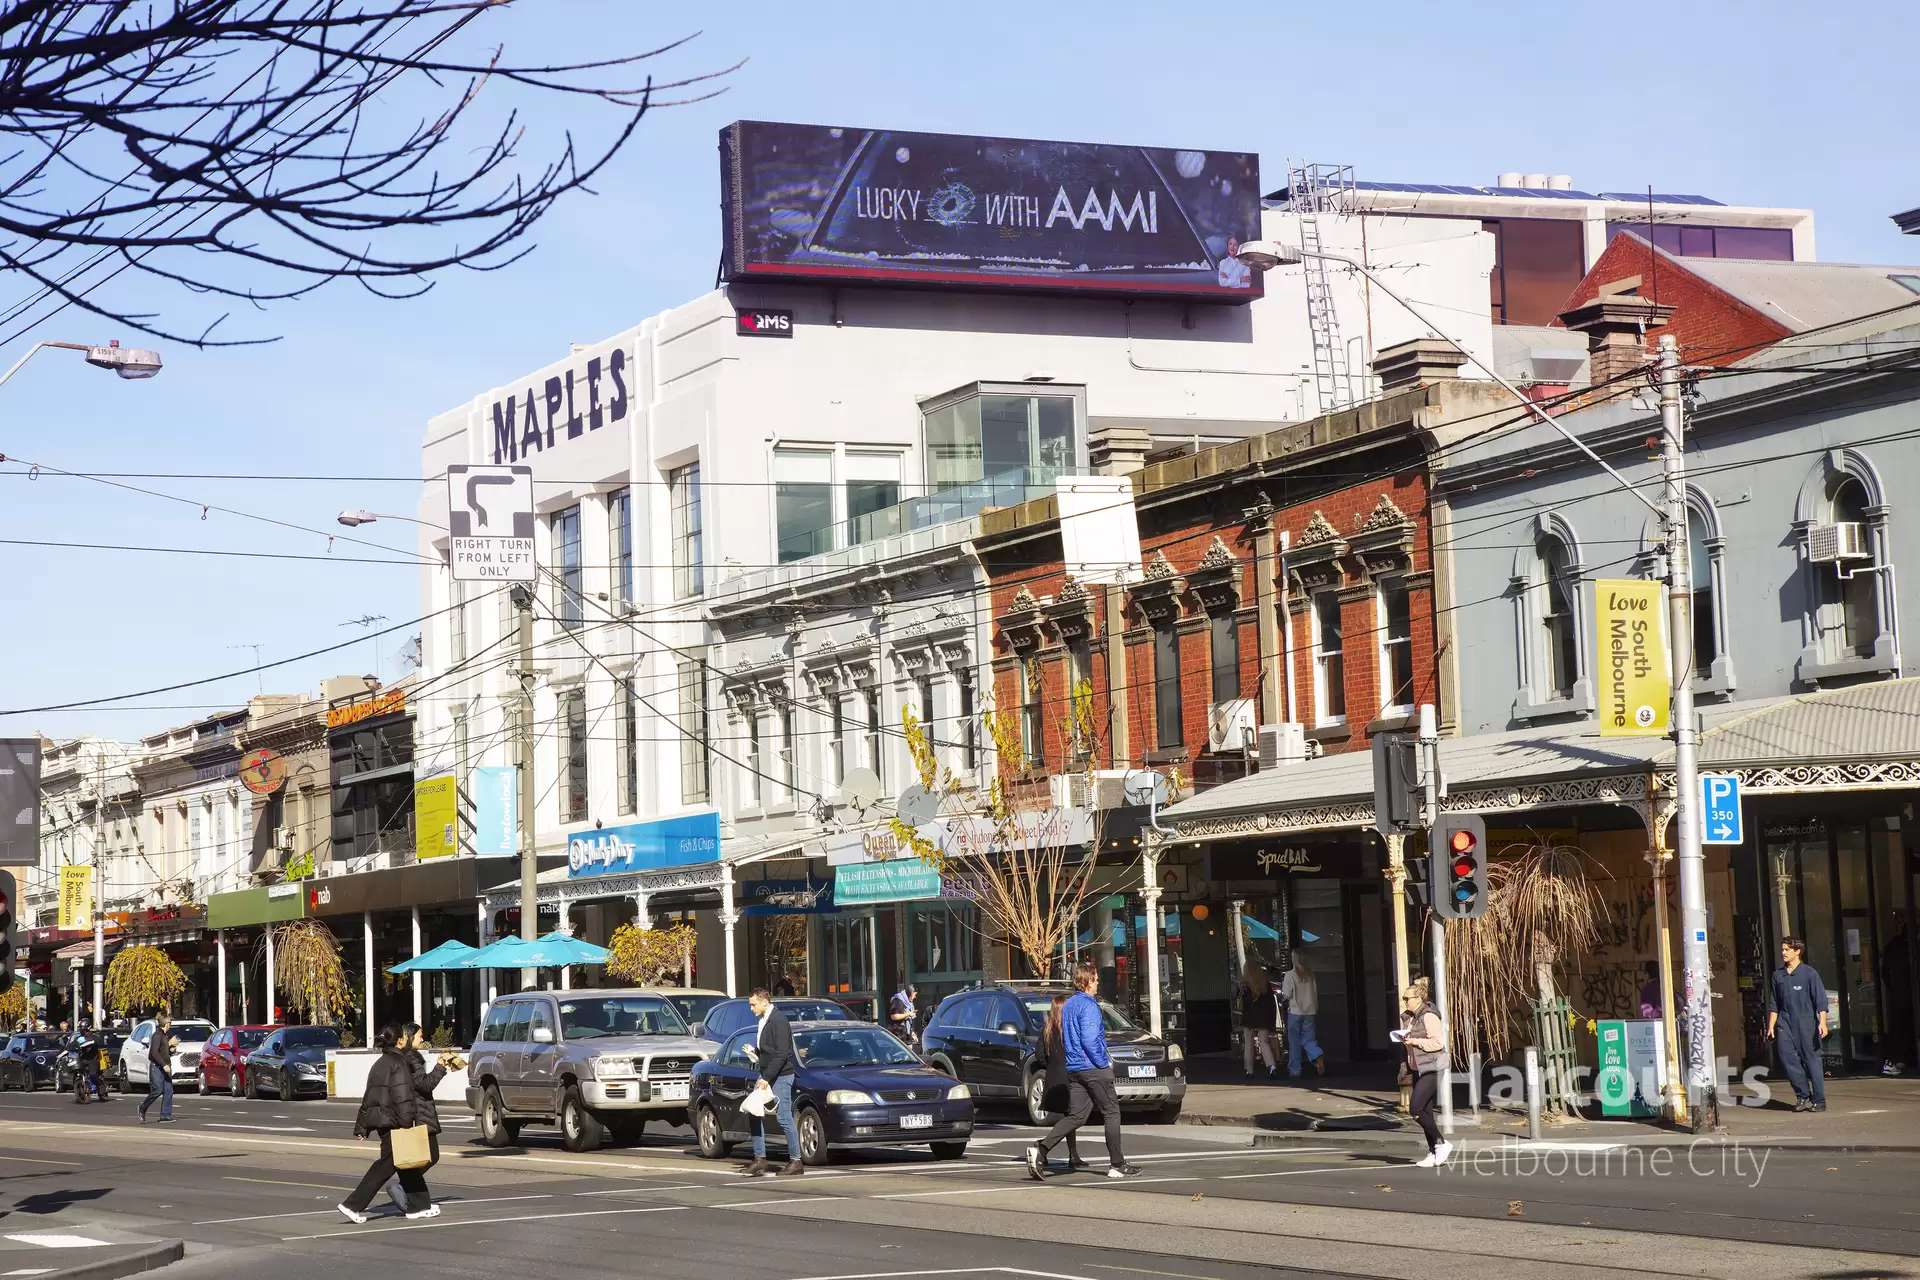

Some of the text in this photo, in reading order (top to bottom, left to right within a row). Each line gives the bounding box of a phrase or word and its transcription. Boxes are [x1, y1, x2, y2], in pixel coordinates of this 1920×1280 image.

[856, 184, 1158, 234] LUCKY WITH AAMI
[750, 312, 790, 331] QMS
[492, 348, 628, 464] MAPLES
[455, 539, 531, 549] RIGHT TURN
[459, 553, 529, 563] FROM LEFT
[479, 566, 510, 576] ONLY
[1609, 591, 1648, 612] Love
[1631, 620, 1652, 679] South
[1610, 618, 1630, 727] Melbourne
[1710, 778, 1731, 808] P
[1711, 811, 1734, 820] 350
[1038, 820, 1059, 836] Food
[680, 838, 714, 853] Fish & Chips
[862, 832, 896, 857] Queen
[66, 870, 85, 878] Love
[861, 867, 893, 880] EXTENSIONS
[861, 881, 896, 894] EXTENSIONS
[897, 878, 930, 891] AVAILABLE
[943, 878, 975, 891] een
[75, 881, 83, 906] South
[317, 886, 331, 904] nab
[65, 881, 74, 926] Melbourne
[1605, 1052, 1621, 1064] Love
